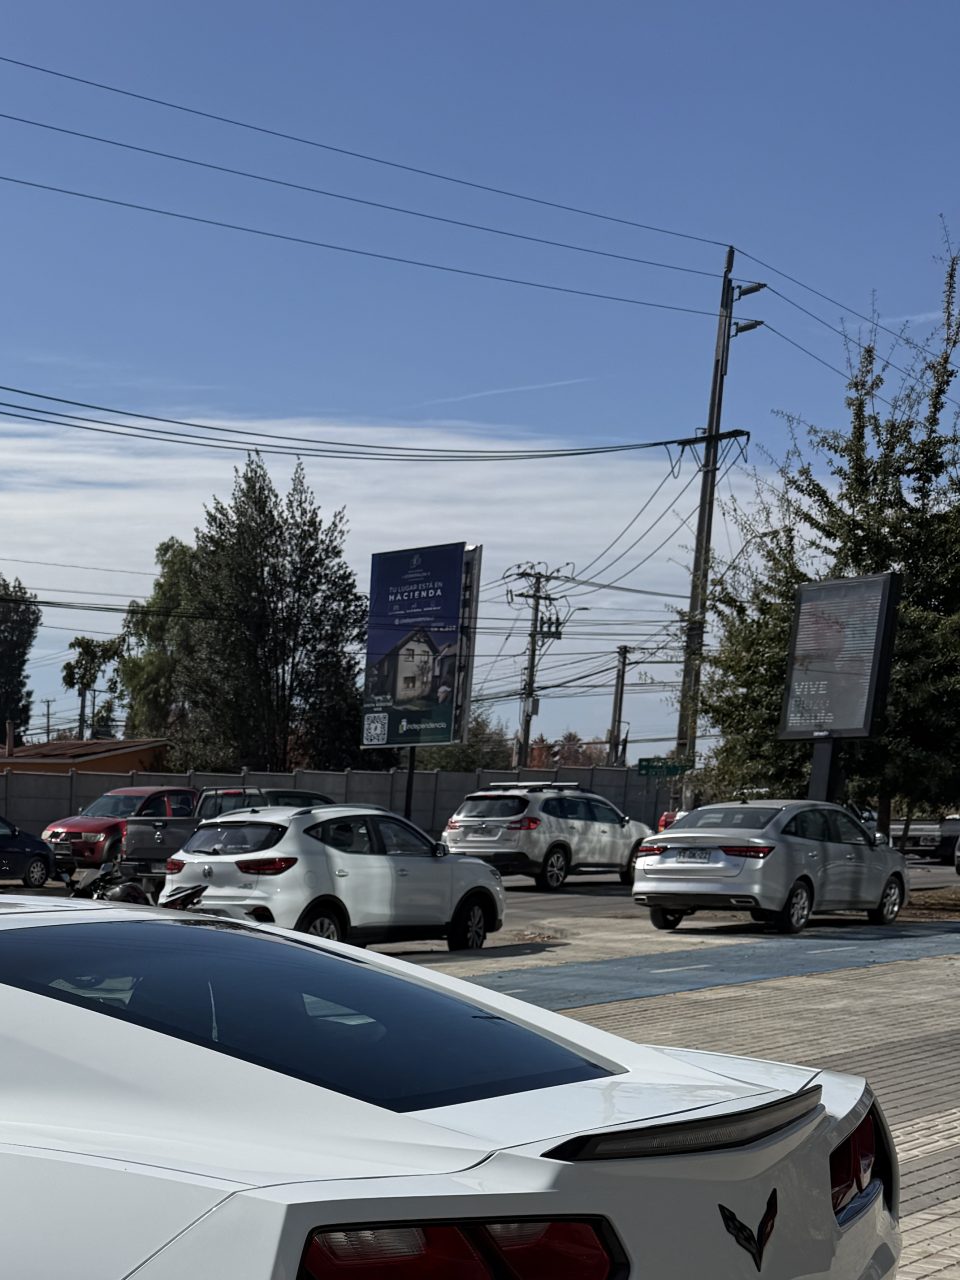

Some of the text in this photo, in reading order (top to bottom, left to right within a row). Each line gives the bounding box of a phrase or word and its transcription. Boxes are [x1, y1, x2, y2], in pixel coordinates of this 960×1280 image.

[398, 583, 417, 592] LUGAR
[388, 588, 442, 602] HACIENDA
[794, 681, 828, 695] VIVE
